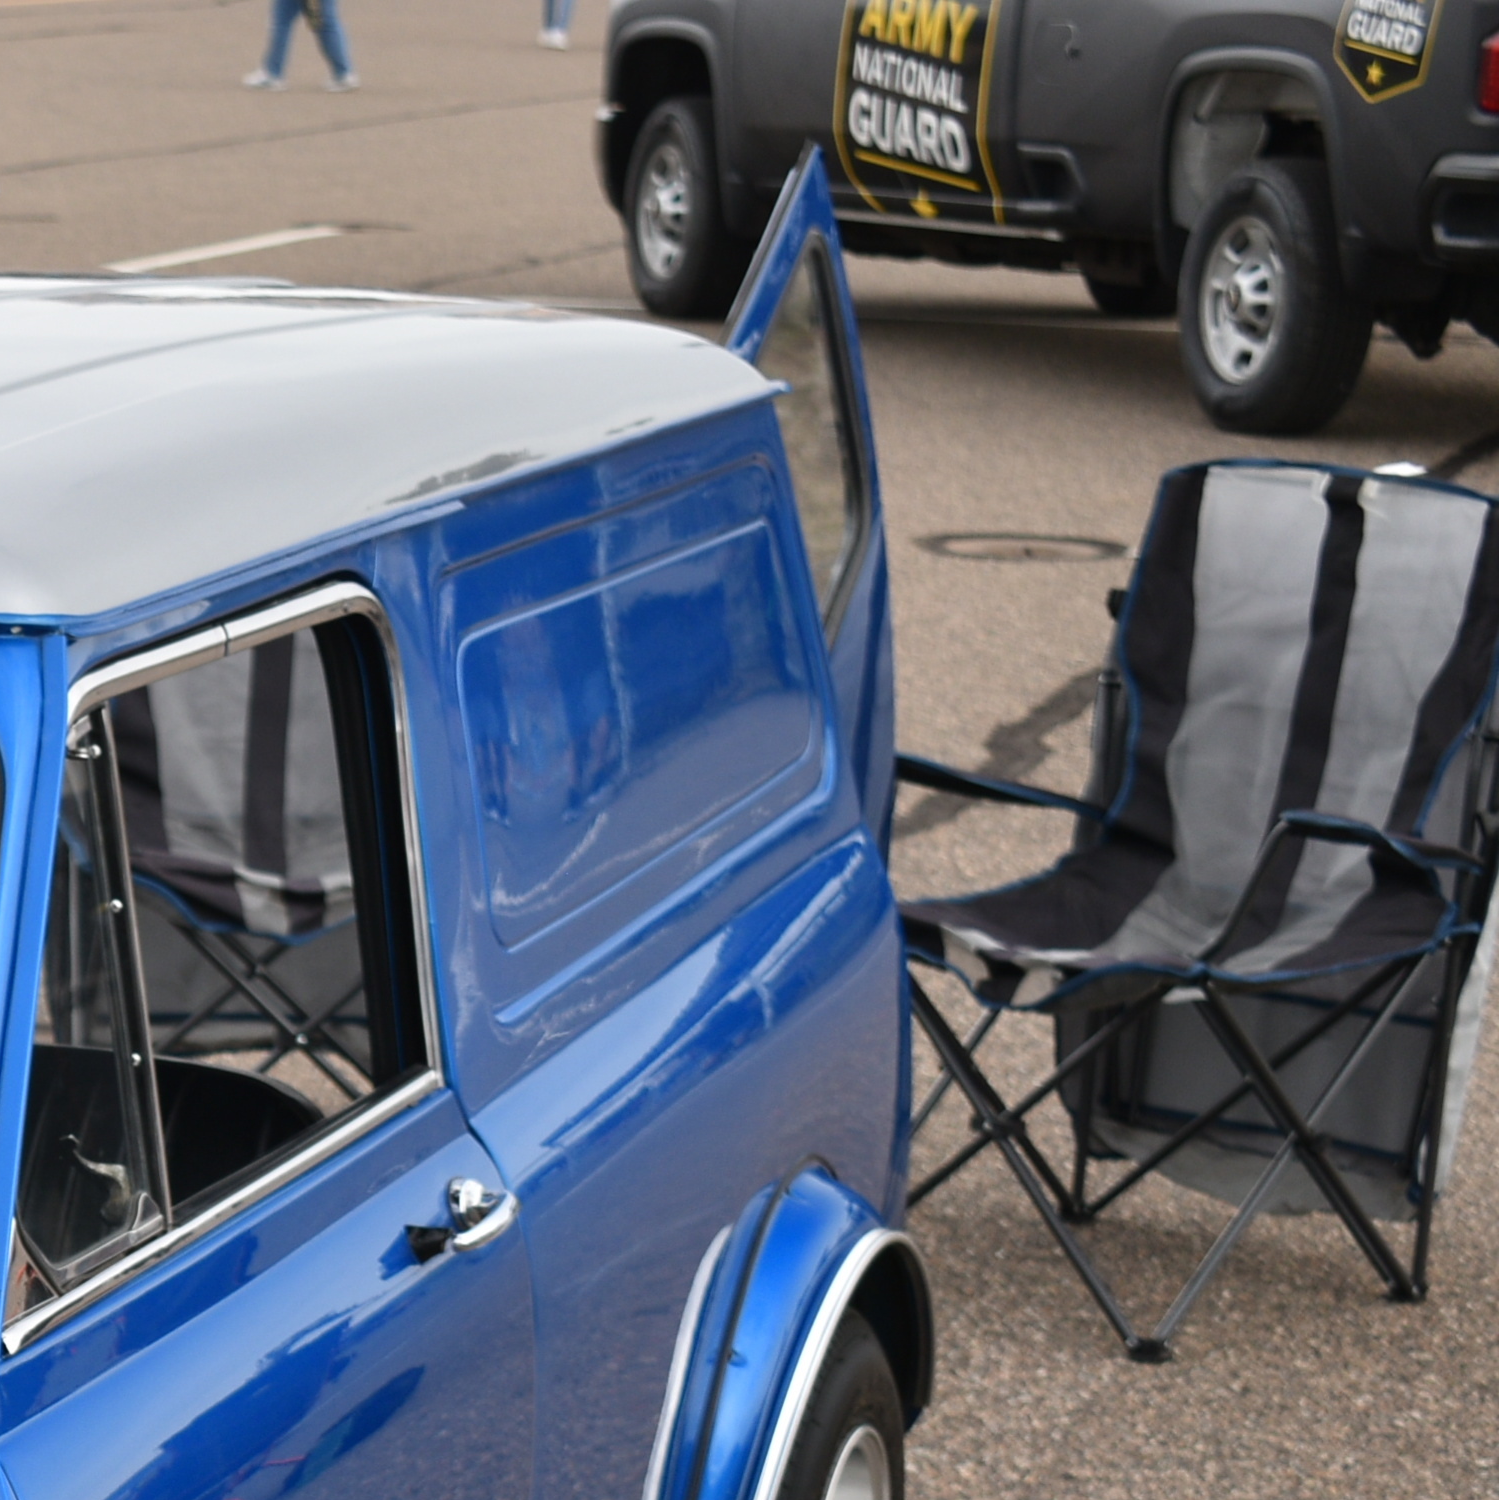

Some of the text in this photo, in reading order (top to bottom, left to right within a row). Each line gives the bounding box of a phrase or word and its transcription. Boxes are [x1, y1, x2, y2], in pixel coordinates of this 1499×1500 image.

[858, 0, 979, 64] ARMY
[1346, 9, 1423, 56] GUARD
[852, 41, 969, 114] NATIONAL
[848, 87, 972, 173] GUARD
